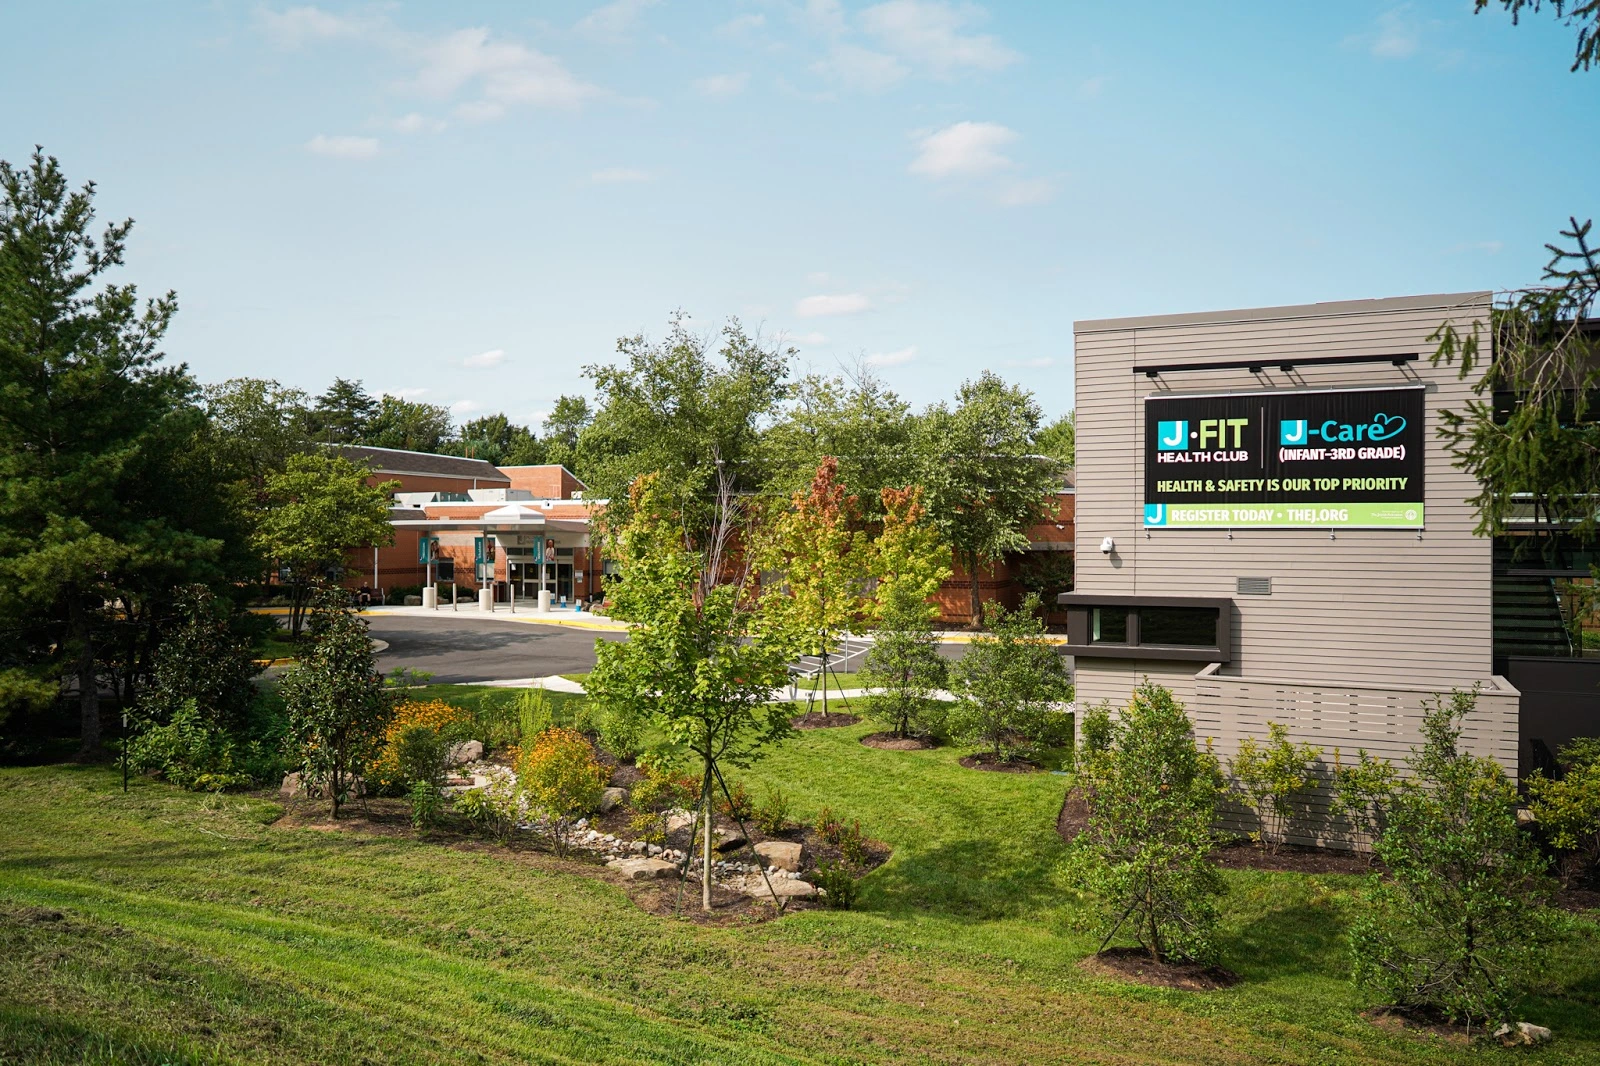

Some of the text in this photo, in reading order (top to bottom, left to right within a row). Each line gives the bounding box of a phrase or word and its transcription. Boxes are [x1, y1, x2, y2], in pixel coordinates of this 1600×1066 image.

[1157, 450, 1249, 463] HEALTH CLUB
[1358, 444, 1406, 461] GRADE)
[1157, 477, 1408, 493] HEALTH & SAFETY IS OUR TOP PRIORITY
[1171, 508, 1349, 524] REGISTER TODAY THEJ.ORG
